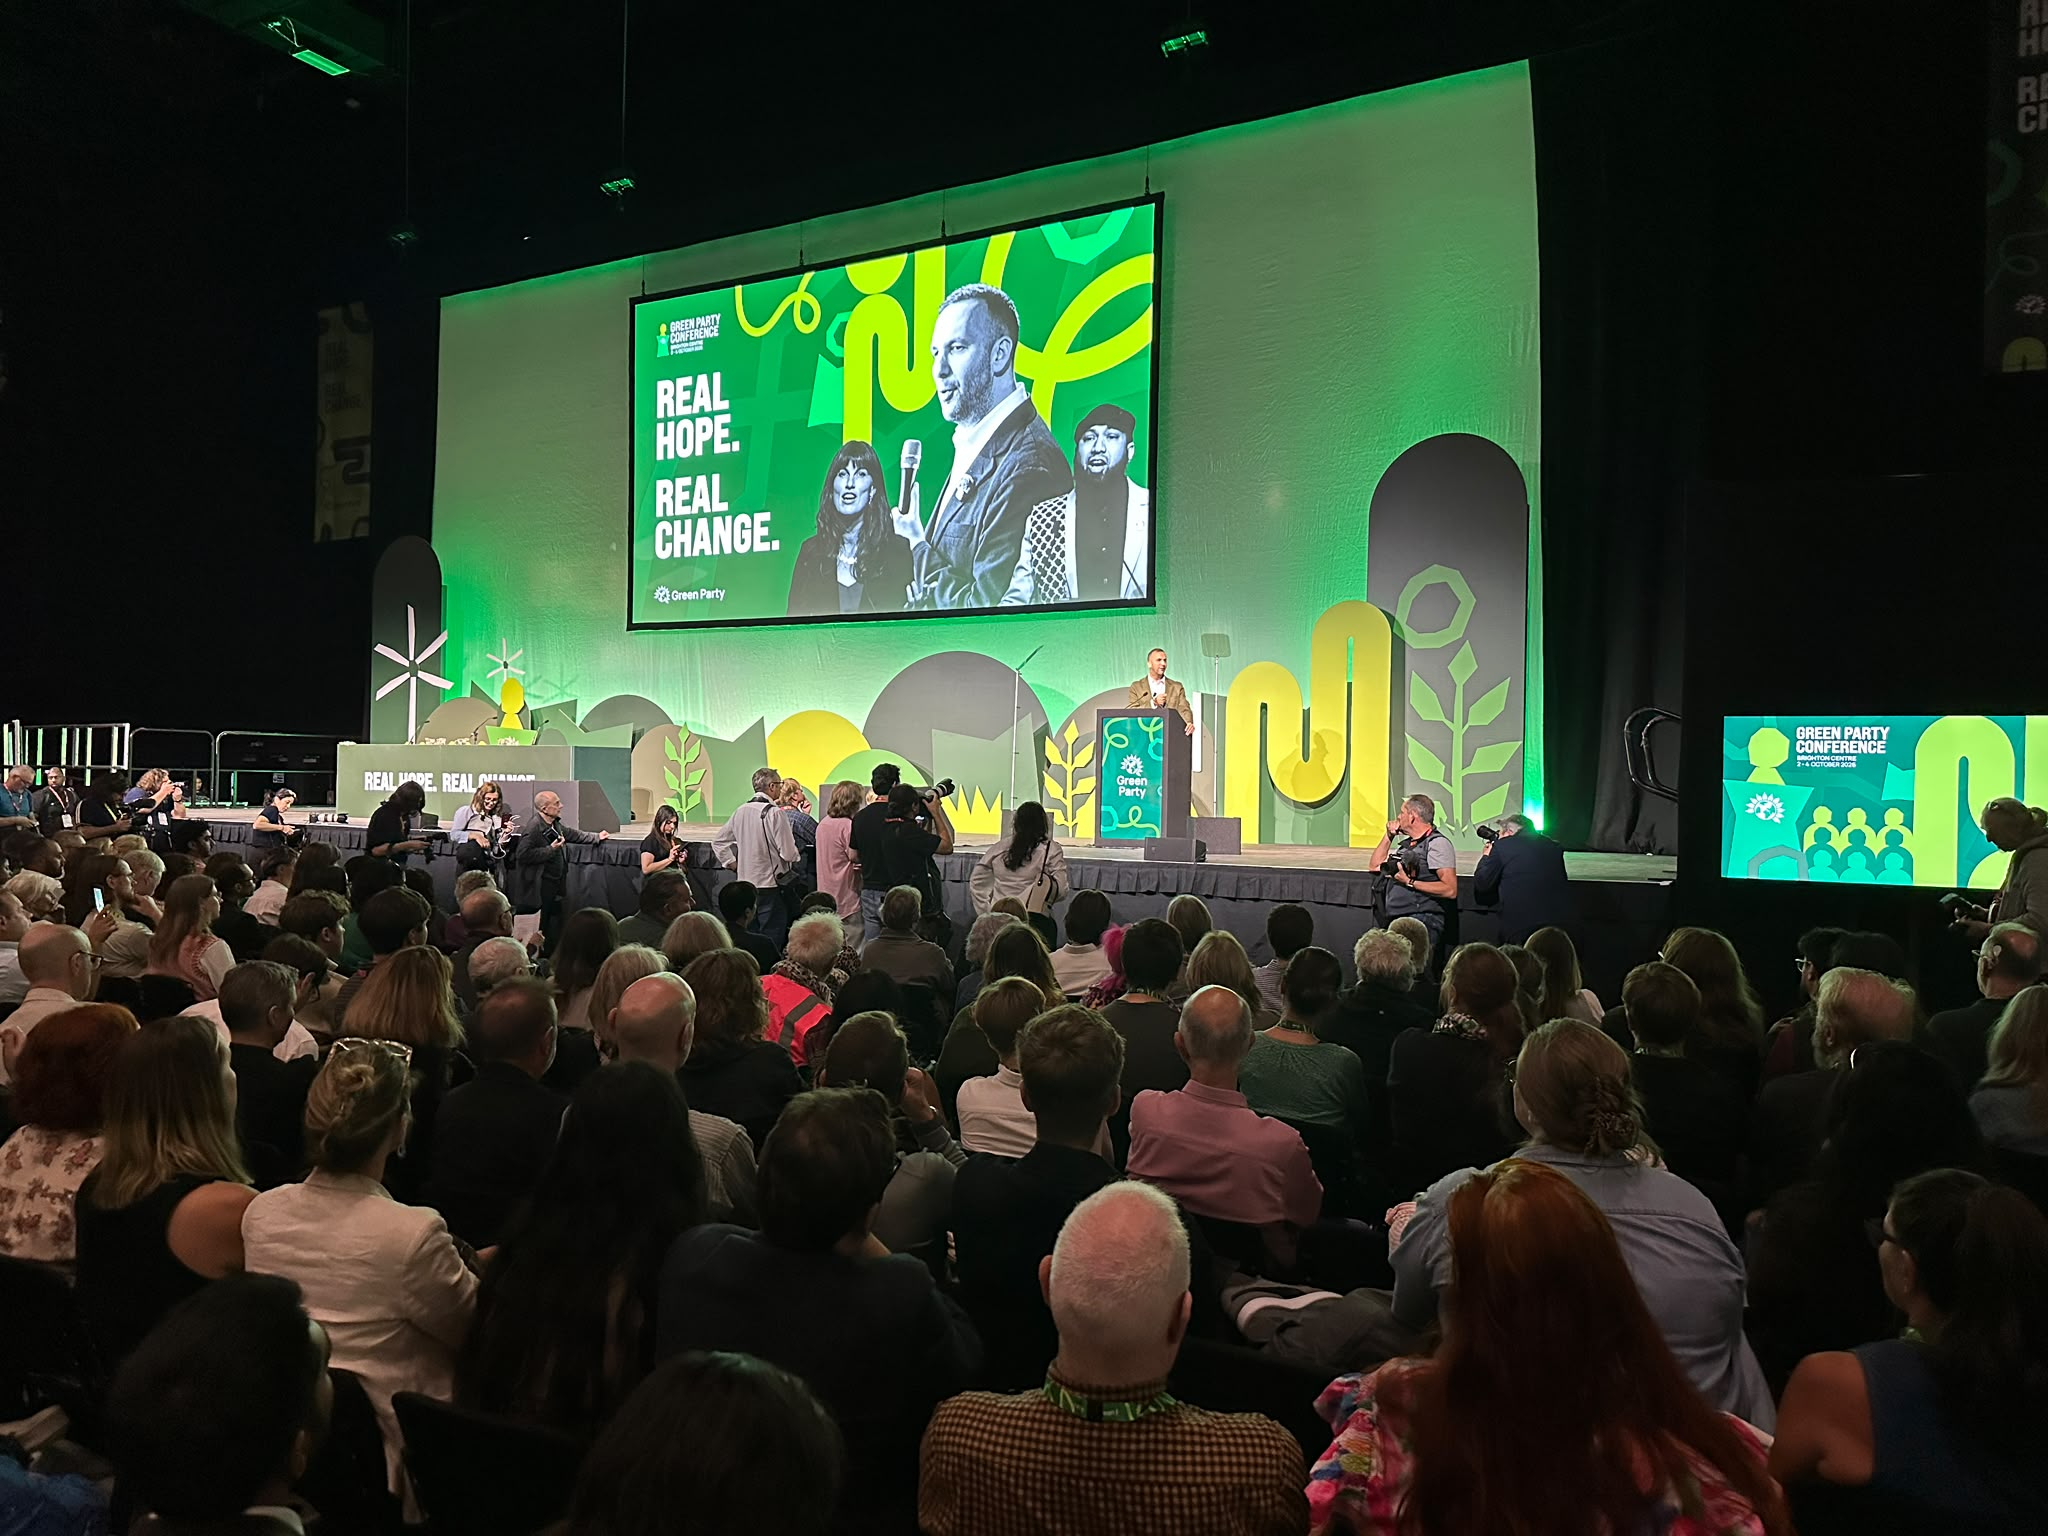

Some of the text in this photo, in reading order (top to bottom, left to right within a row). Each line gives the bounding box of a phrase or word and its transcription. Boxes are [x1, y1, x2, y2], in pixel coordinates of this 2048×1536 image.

[670, 312, 721, 333] GREEN PARTY
[670, 325, 719, 344] CONFERENCE
[656, 371, 730, 419] REAL
[656, 413, 740, 461] HOPE.
[655, 473, 729, 518] REAL
[655, 511, 780, 560] CHANGE.
[671, 588, 725, 601] Green Party
[1795, 726, 1890, 740] GREEN PARTY
[1795, 740, 1886, 754] CONFERENCE
[364, 771, 397, 792] REAL
[442, 772, 477, 793] REAL
[1116, 775, 1148, 786] Green
[1118, 786, 1147, 800] Party
